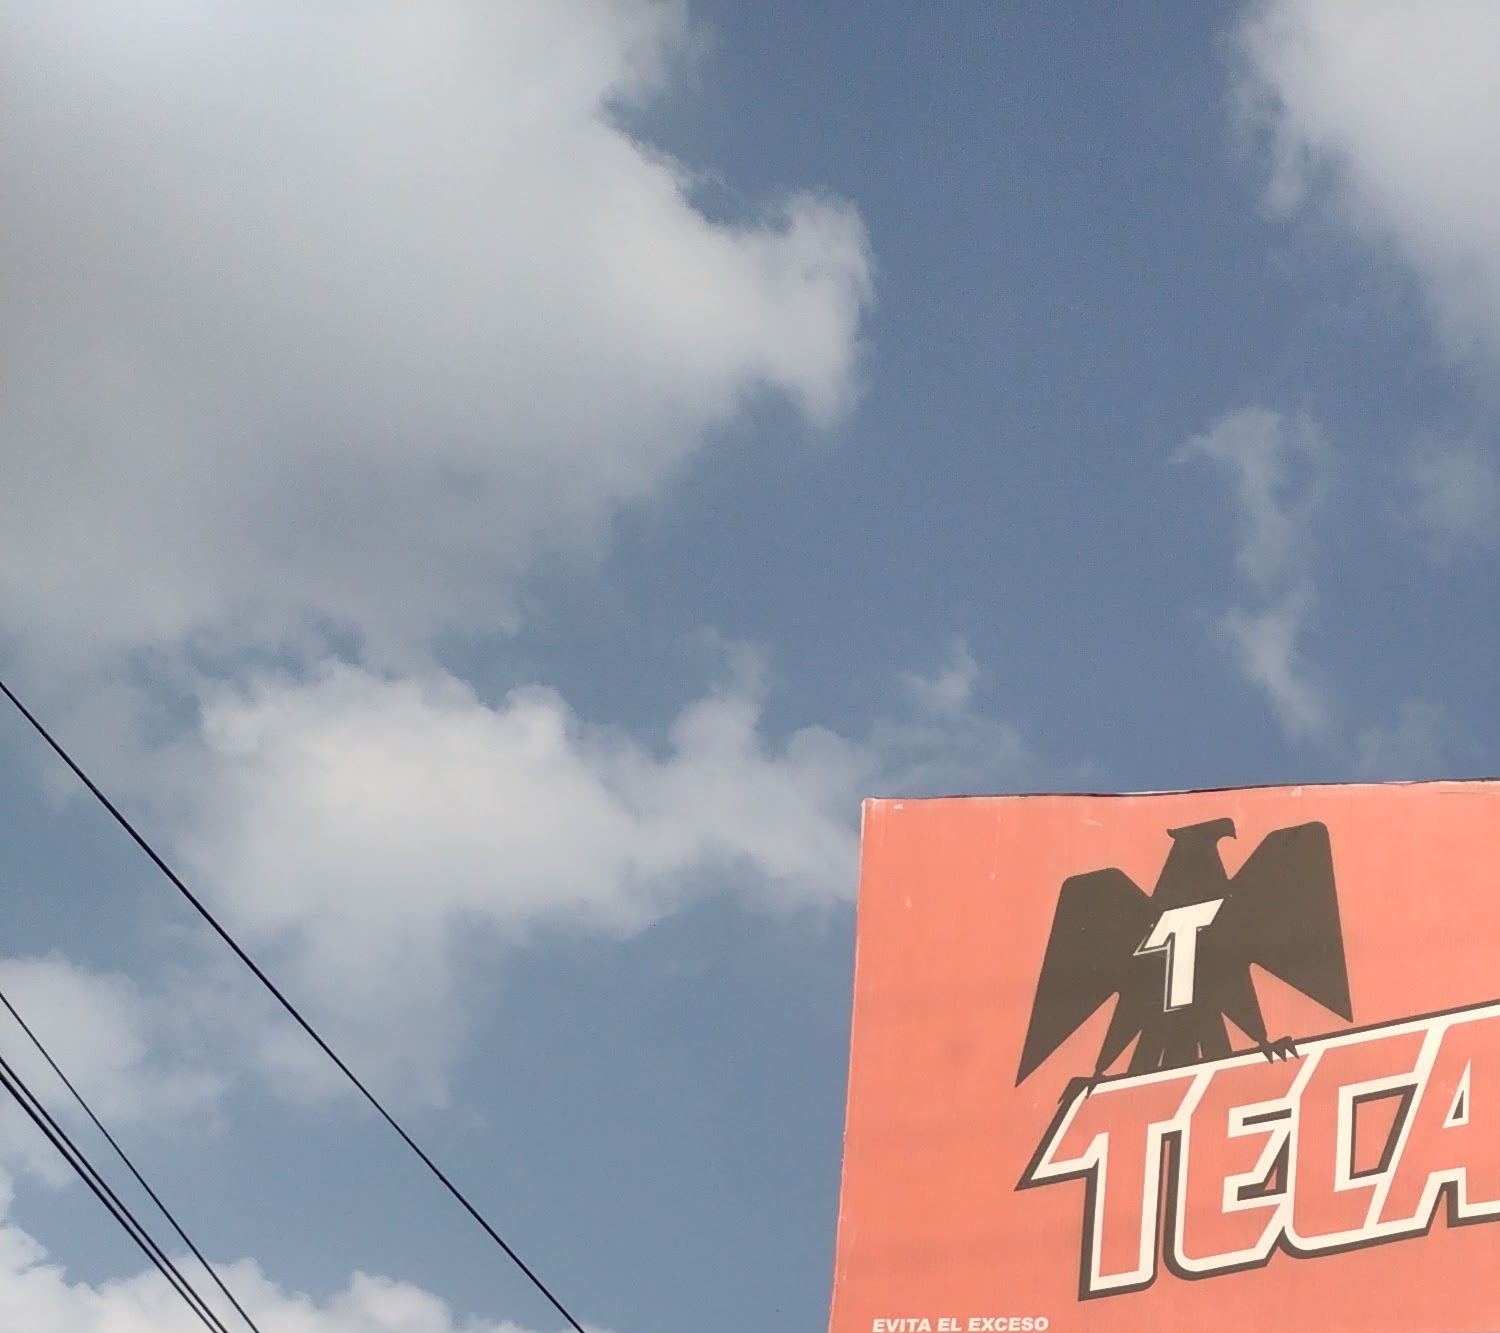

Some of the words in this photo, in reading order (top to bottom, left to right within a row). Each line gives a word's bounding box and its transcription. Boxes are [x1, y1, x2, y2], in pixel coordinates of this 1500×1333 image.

[872, 1318, 931, 1333] EVITA
[937, 1318, 962, 1332] EL
[968, 1317, 1049, 1333] EXCESO
